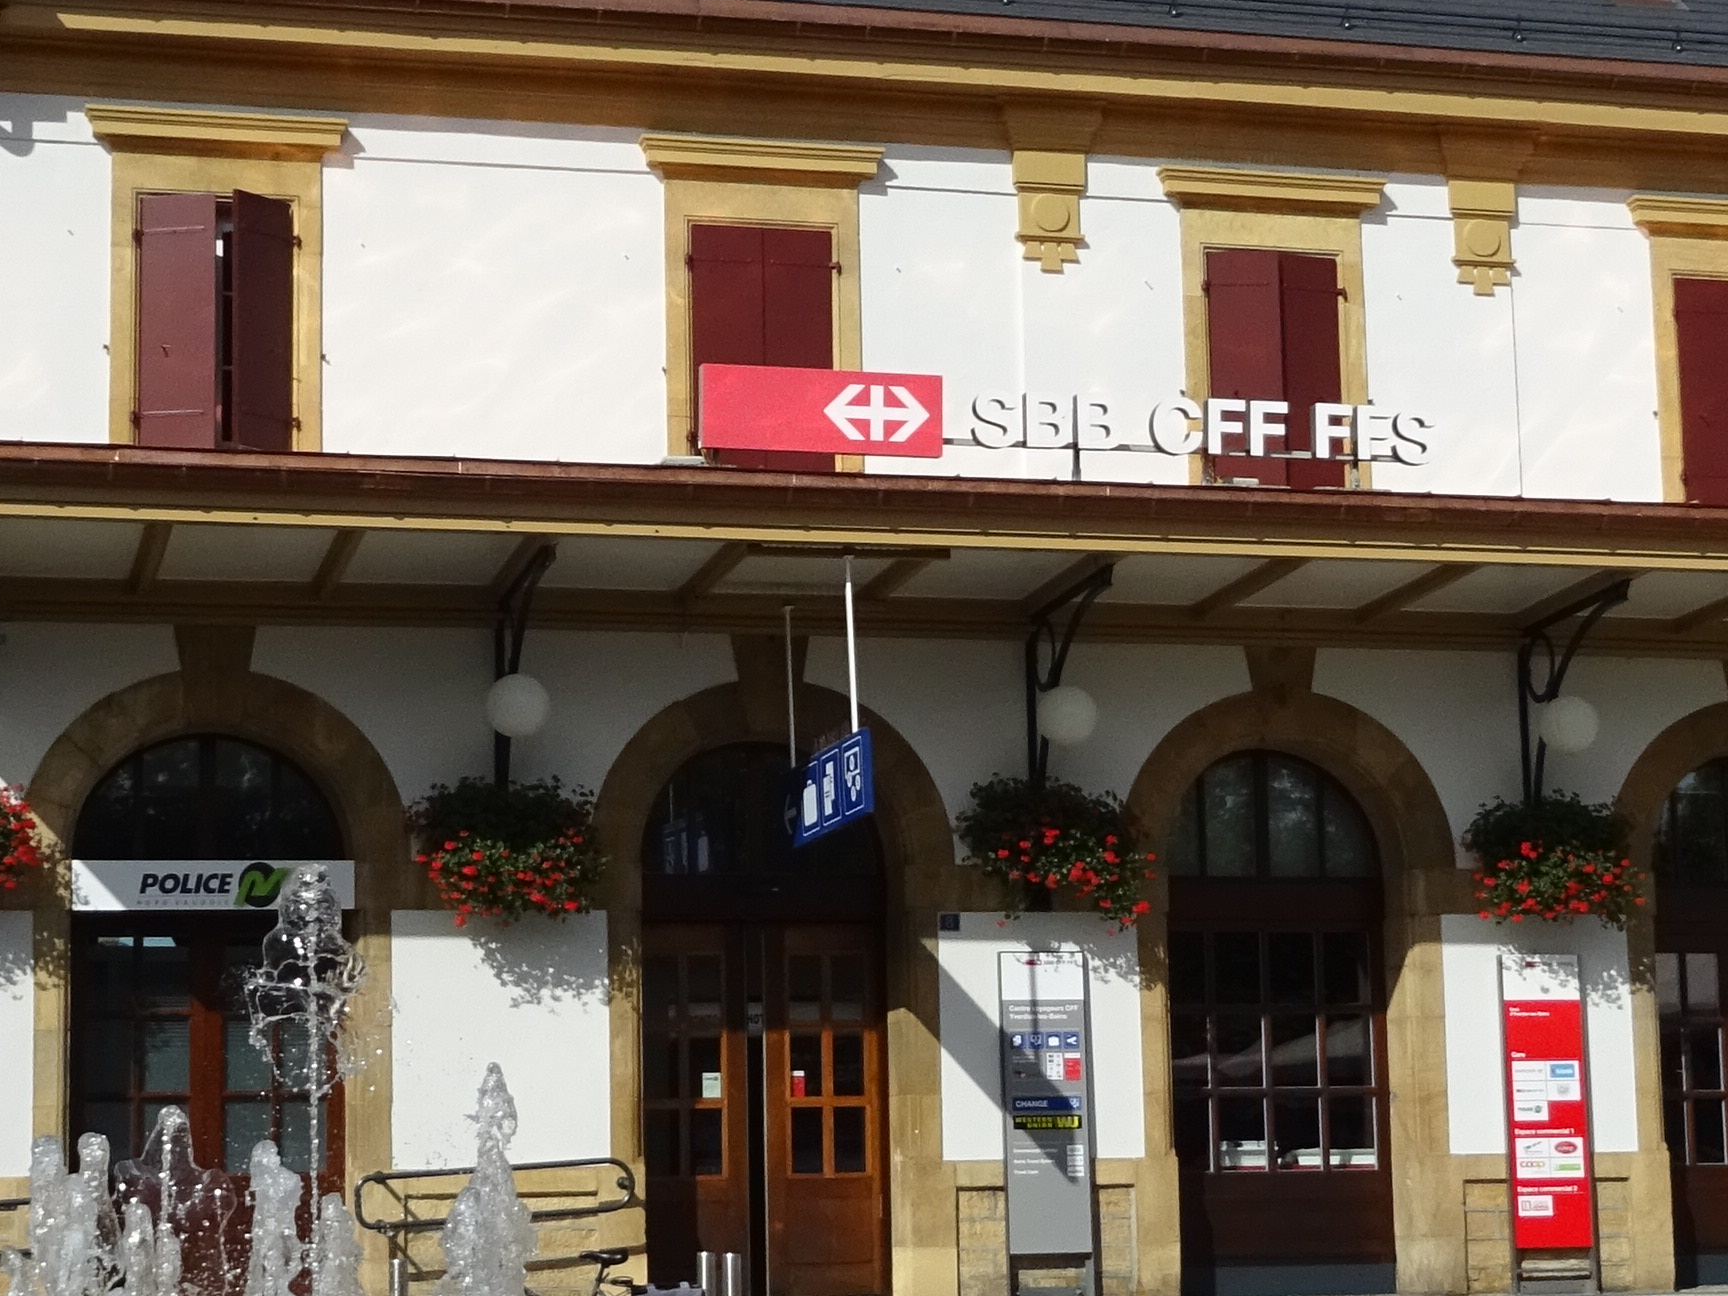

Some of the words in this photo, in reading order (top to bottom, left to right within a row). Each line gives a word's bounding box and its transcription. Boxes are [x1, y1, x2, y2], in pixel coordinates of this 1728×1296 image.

[972, 391, 1119, 449] SBB
[1149, 394, 1289, 457] CFF
[1312, 402, 1436, 467] FFS
[139, 873, 233, 895] POLICE
[1015, 1100, 1049, 1108] CHANGE
